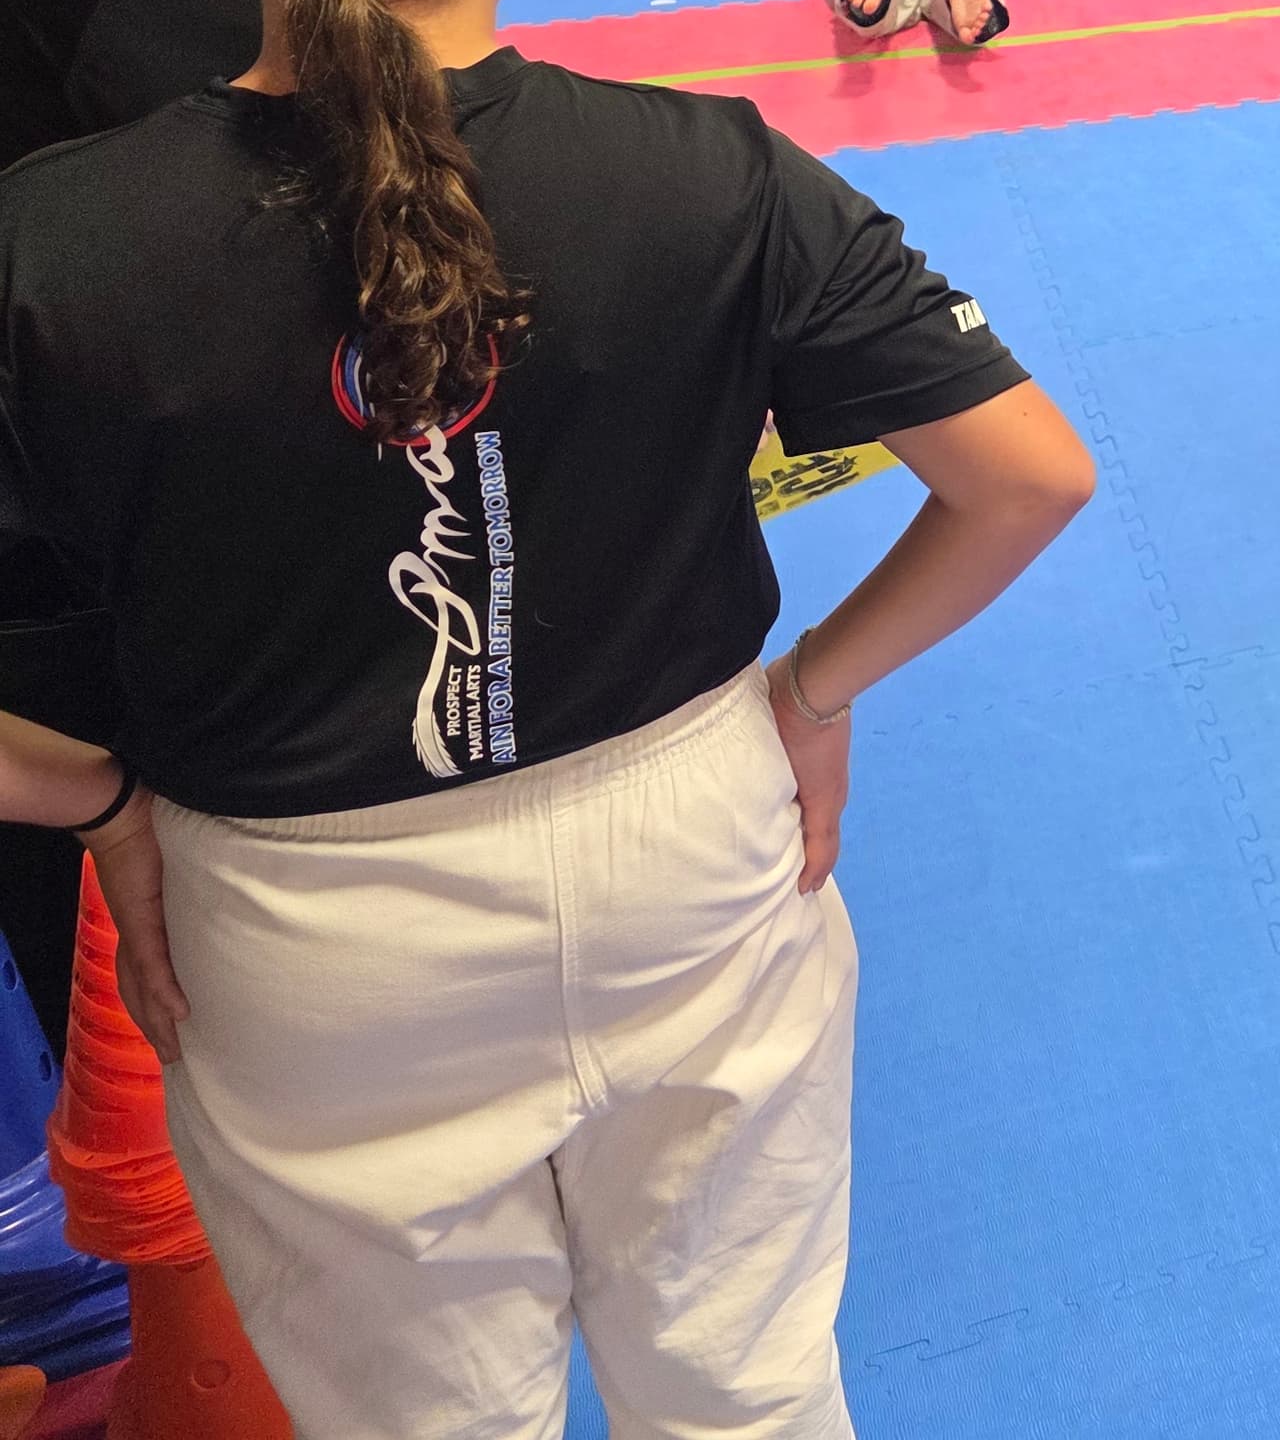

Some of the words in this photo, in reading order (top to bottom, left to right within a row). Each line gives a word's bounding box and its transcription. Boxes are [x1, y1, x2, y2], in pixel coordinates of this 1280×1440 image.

[475, 430, 514, 566] TOMORROW
[487, 565, 514, 656] BETTER
[466, 664, 481, 701] ARTS
[487, 655, 512, 678] A
[446, 664, 462, 736] PROSPECT
[487, 679, 514, 725] FOR
[467, 701, 484, 761] MARTIAL
[489, 722, 517, 763] AIN
